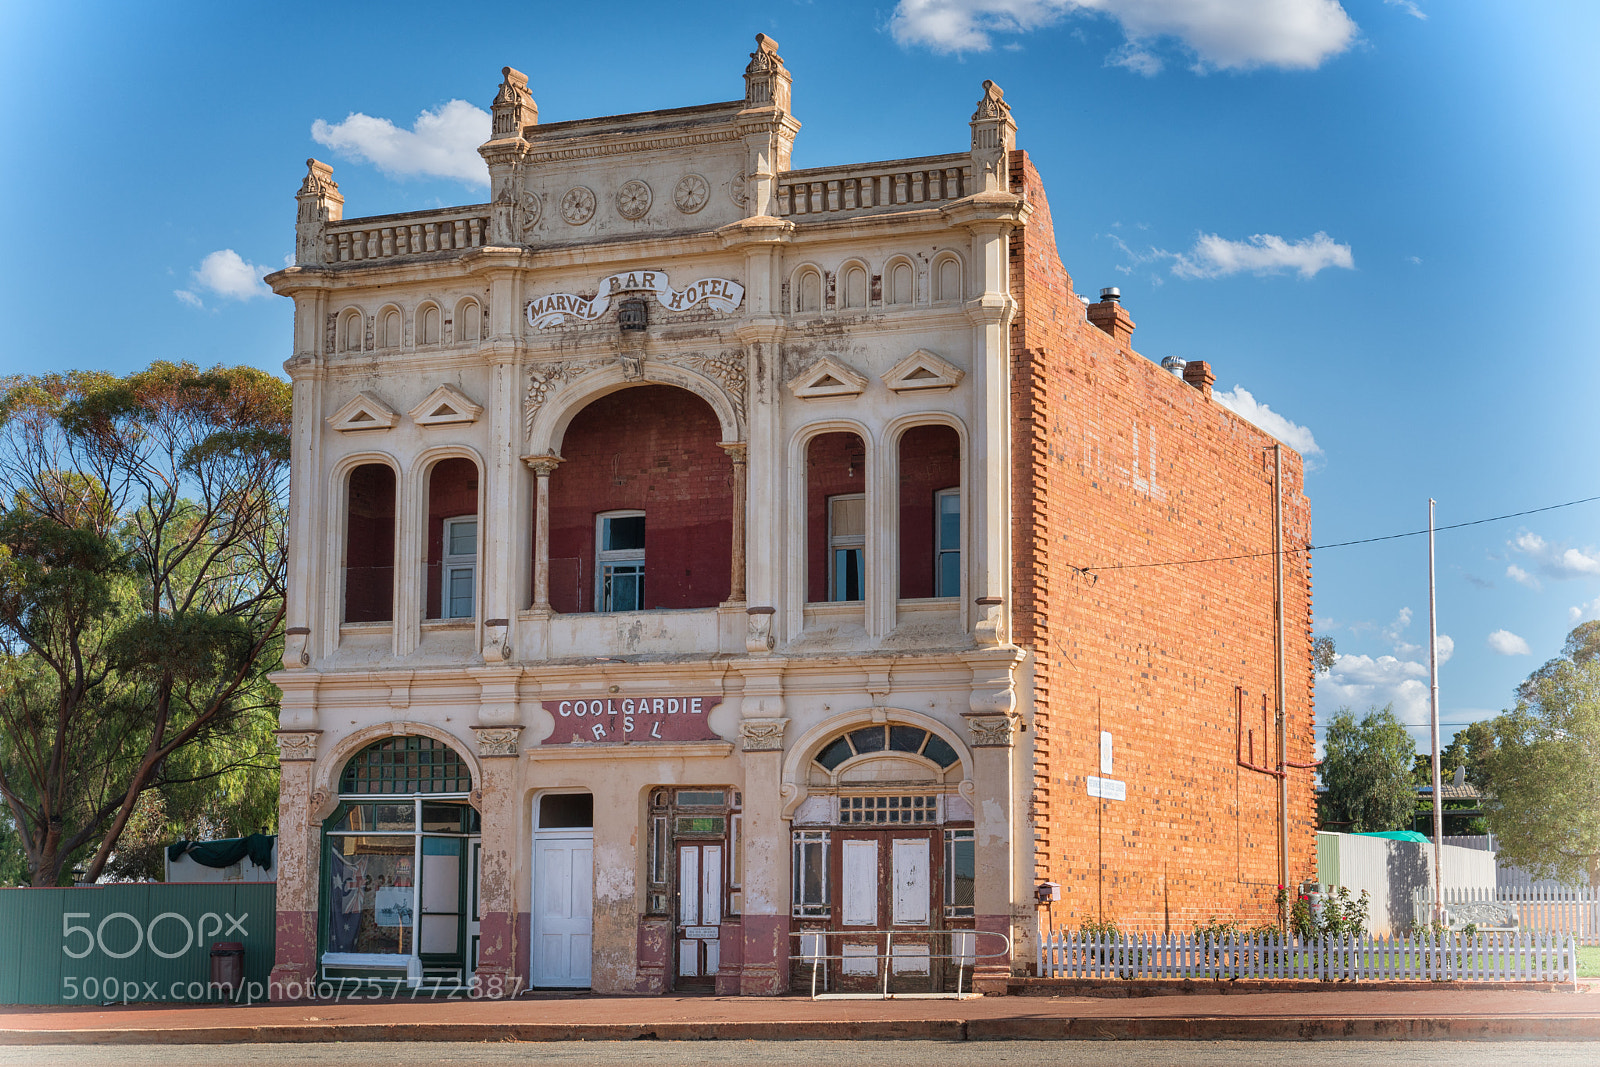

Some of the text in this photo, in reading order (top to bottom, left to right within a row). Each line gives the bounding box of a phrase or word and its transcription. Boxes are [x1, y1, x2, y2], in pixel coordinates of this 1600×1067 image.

[530, 272, 734, 321] MARVEL BAR HOTEL
[558, 698, 703, 717] COOLGARDIE
[591, 716, 662, 741] R S L
